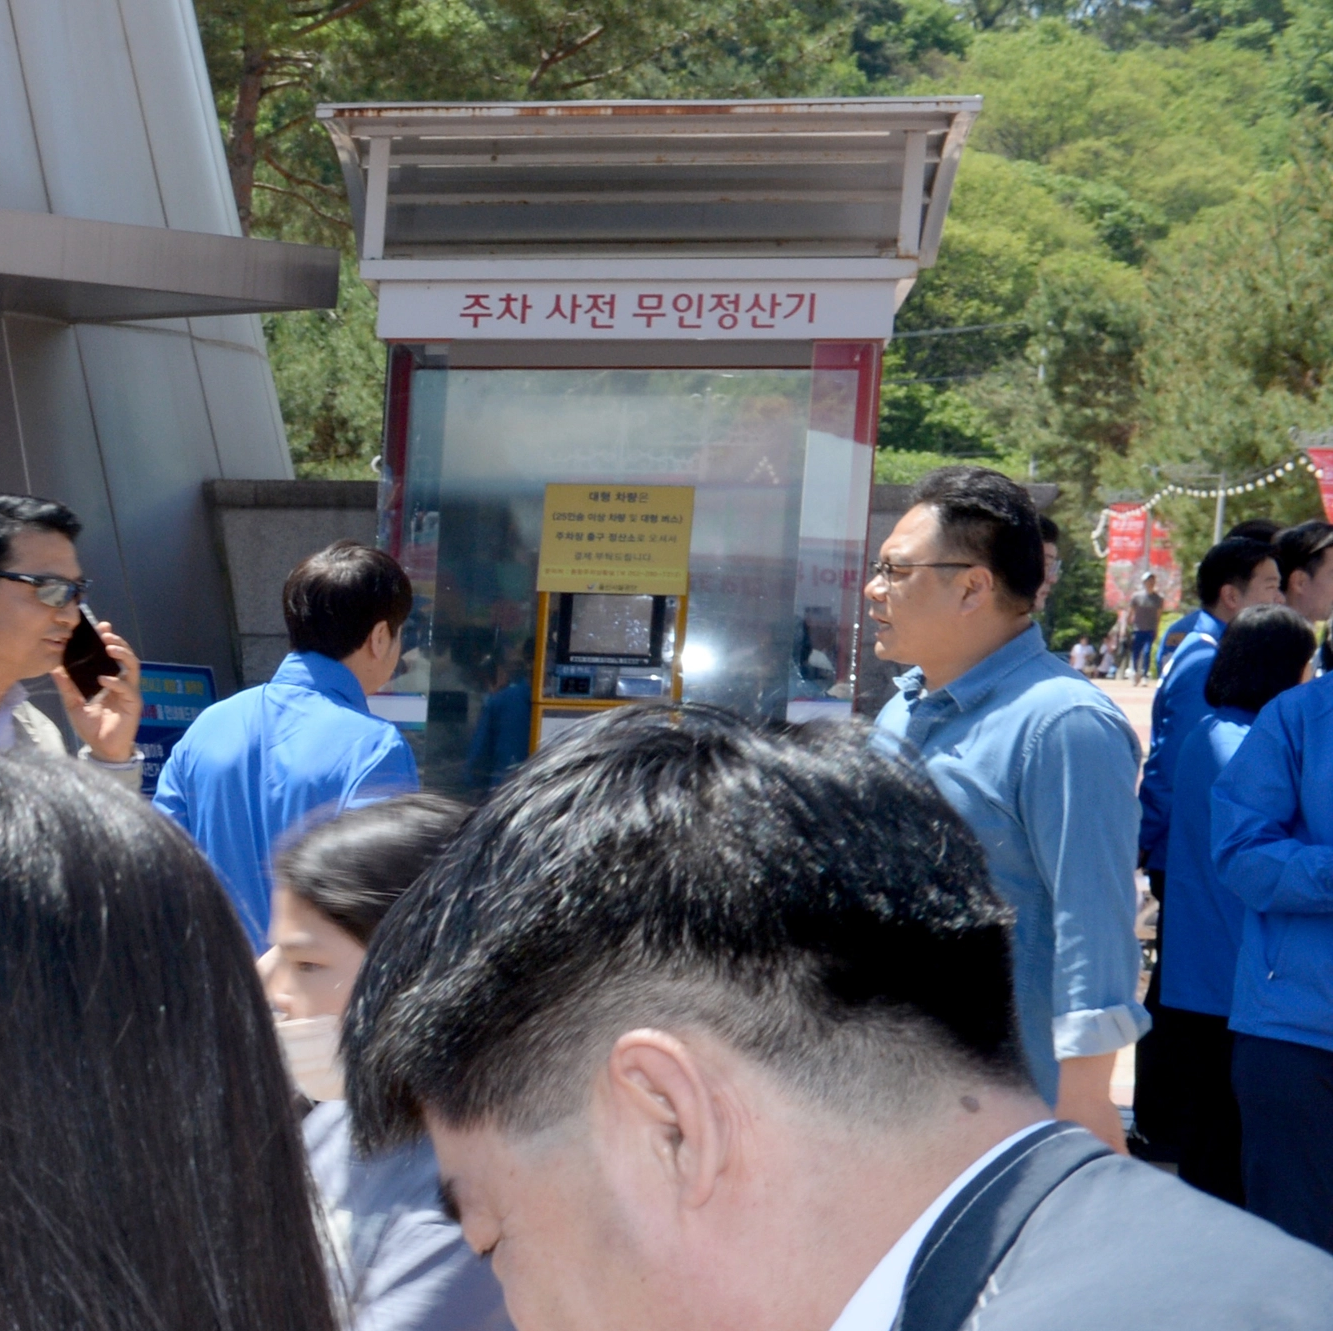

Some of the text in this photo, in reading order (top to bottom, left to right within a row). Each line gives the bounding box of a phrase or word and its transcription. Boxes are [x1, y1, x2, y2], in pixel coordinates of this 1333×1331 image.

[459, 292, 817, 330] 주차 사전 무인정산기
